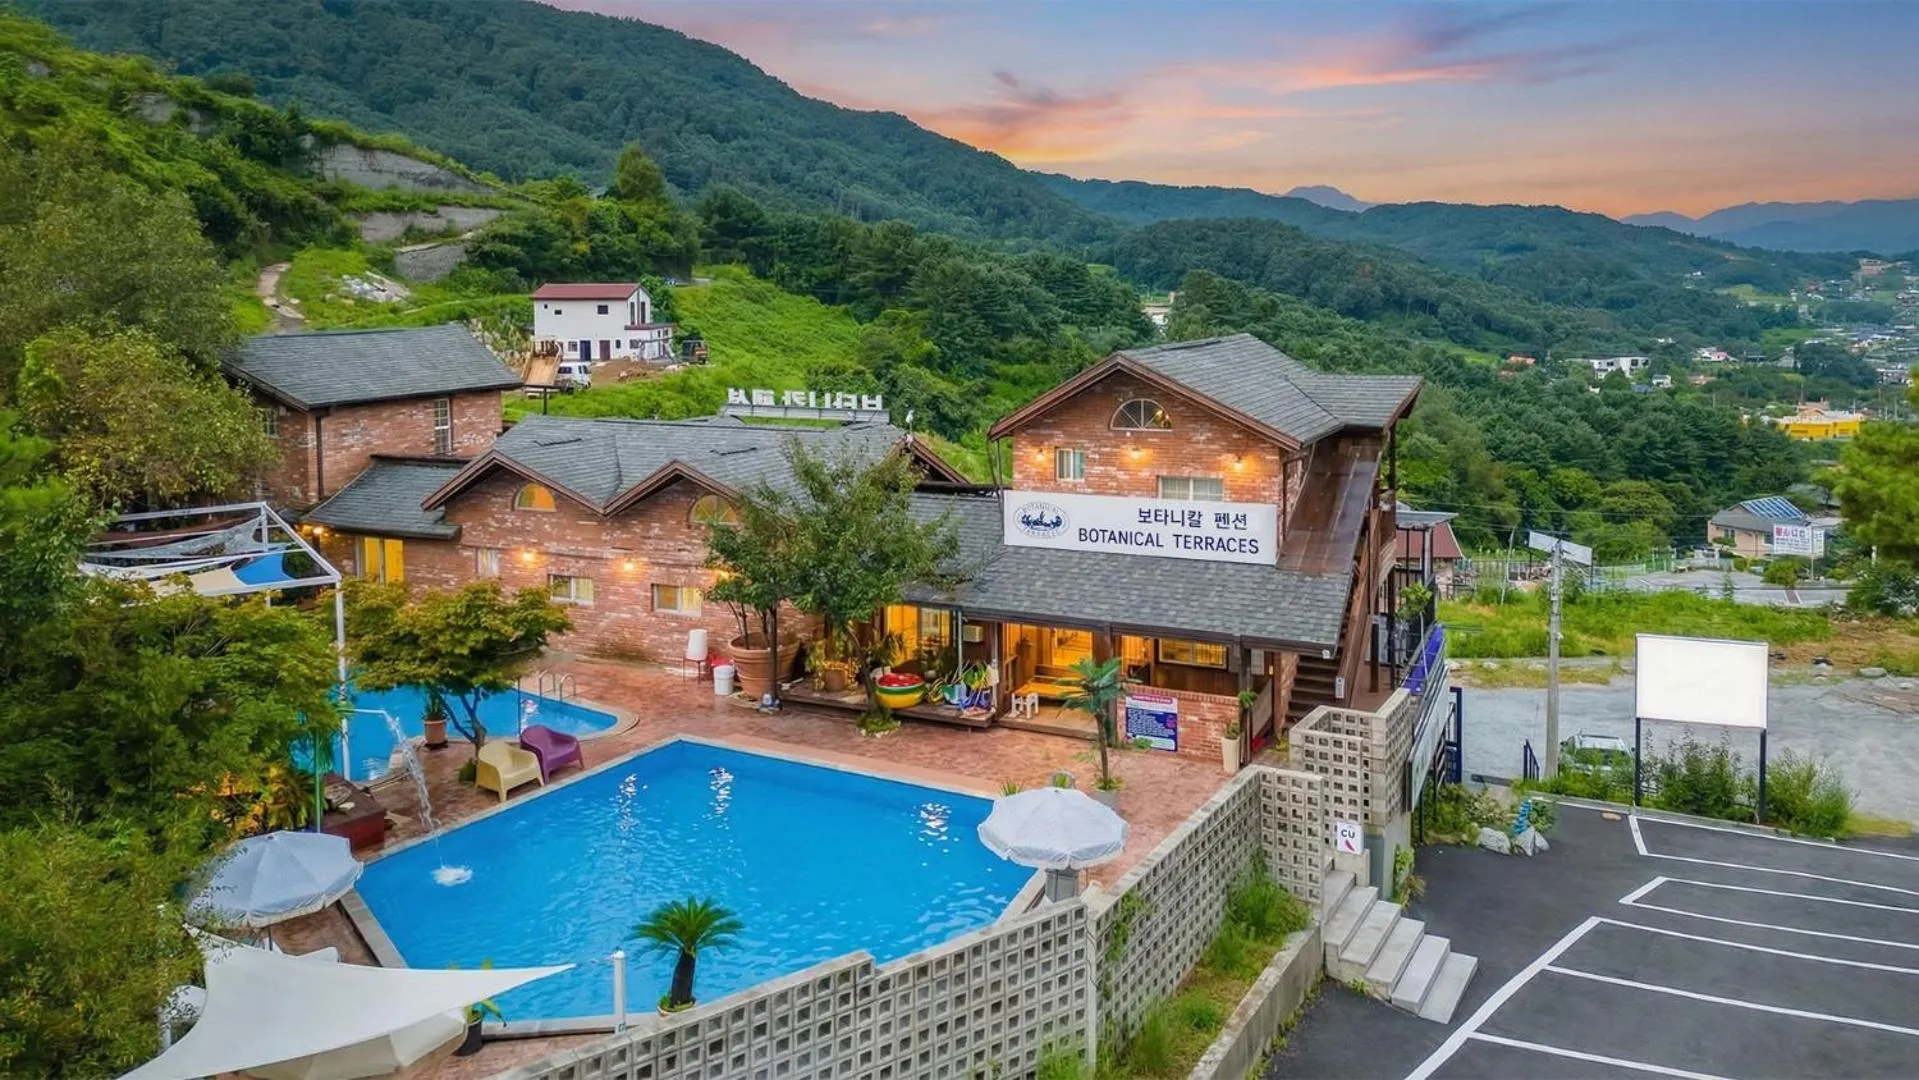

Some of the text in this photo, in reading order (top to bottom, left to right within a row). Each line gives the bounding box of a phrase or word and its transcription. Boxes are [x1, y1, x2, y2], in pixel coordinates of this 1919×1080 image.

[1138, 507, 1247, 530] 보타니칼 펜션
[1078, 527, 1260, 554] BOTANICAL TERRACES
